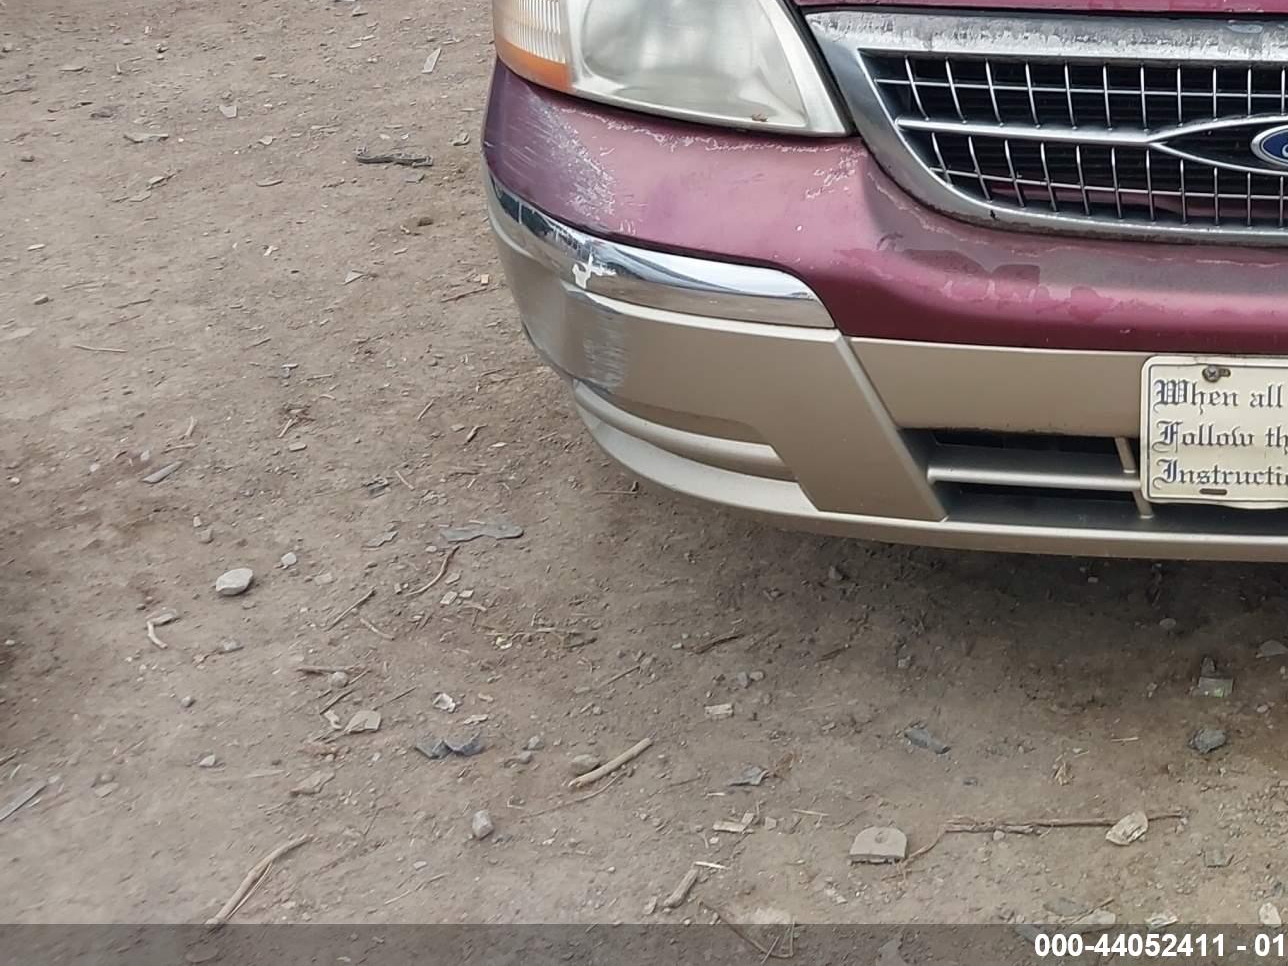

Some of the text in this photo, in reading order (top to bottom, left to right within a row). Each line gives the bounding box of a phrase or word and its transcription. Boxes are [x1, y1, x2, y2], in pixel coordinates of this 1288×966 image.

[1153, 378, 1239, 415] When
[1249, 385, 1284, 409] all
[1152, 420, 1255, 454] Follow
